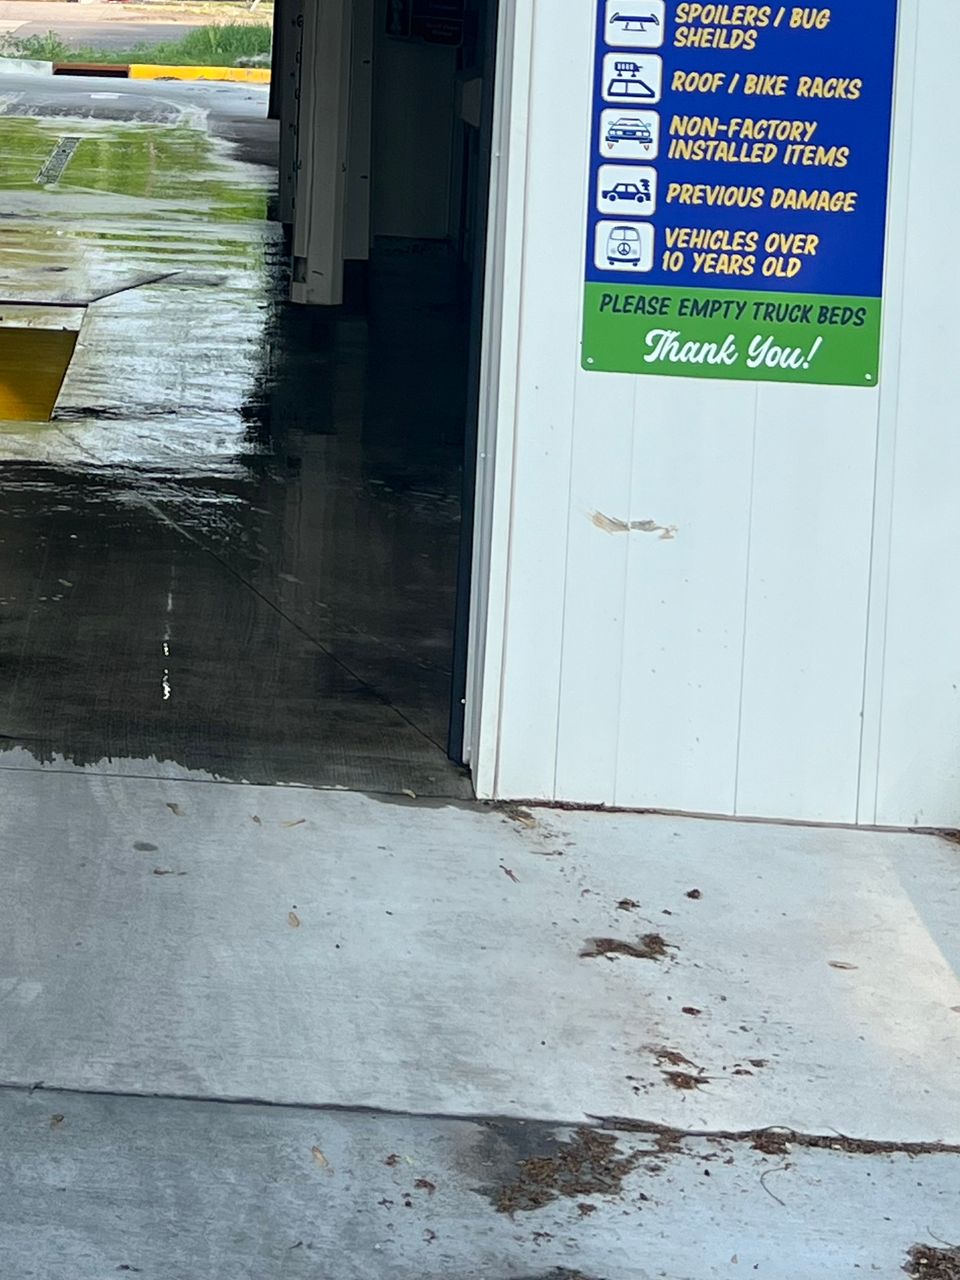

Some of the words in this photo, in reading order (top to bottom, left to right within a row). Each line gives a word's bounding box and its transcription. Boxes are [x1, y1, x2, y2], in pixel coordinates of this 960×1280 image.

[675, 3, 771, 27] SPOILERS
[774, 7, 785, 27] /
[790, 8, 830, 29] BUG
[674, 28, 757, 50] SHEILDS
[671, 71, 725, 93] ROOF
[728, 73, 739, 93] /
[744, 75, 788, 96] BIKE
[797, 77, 862, 99] RACKS
[669, 115, 817, 142] NON-FACTORY
[668, 140, 777, 164] INSTALLED
[783, 145, 849, 167] ITEMS
[666, 183, 765, 208] PREVIOUS
[771, 189, 858, 212] DAMAGE
[665, 228, 757, 252] VEHICLES
[765, 233, 819, 255] OVER
[662, 251, 683, 271] 10
[692, 253, 754, 275] YEARS
[762, 256, 801, 278] OLD
[599, 294, 671, 316] PLEASE
[678, 299, 748, 320] EMPTY
[753, 302, 813, 323] TRUCK
[817, 305, 866, 326] BEDS
[643, 329, 738, 365] Thank
[746, 335, 822, 369] You!
